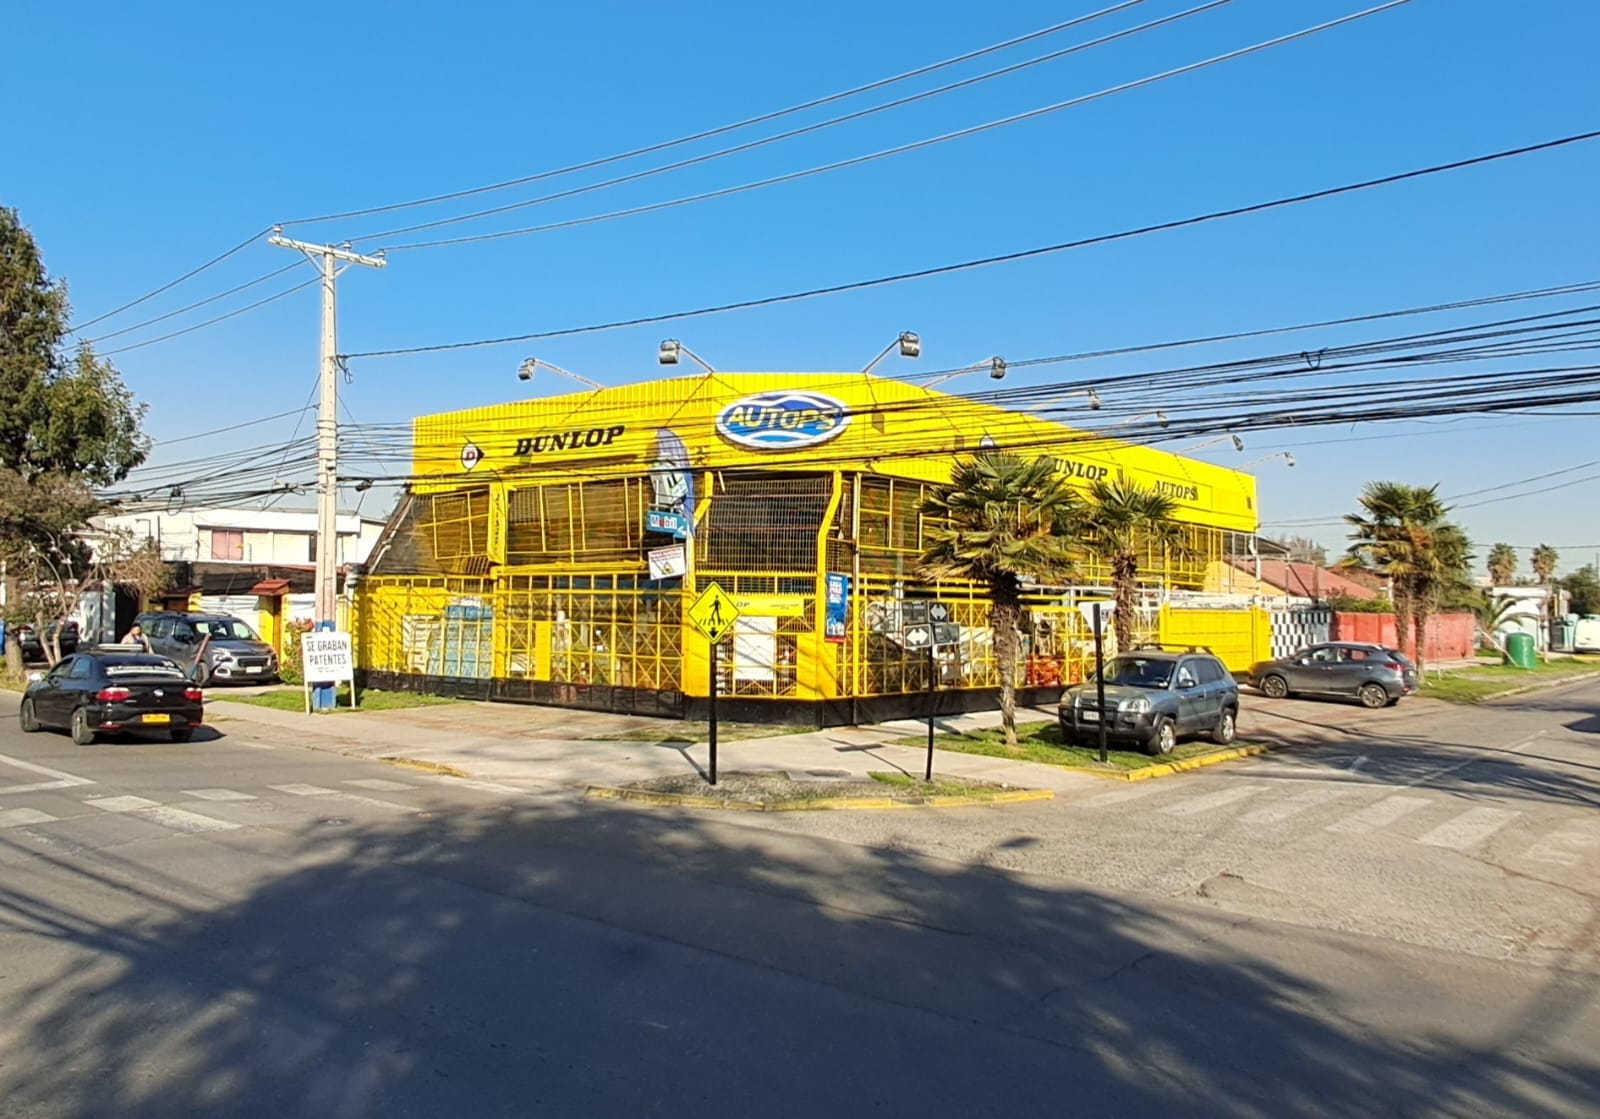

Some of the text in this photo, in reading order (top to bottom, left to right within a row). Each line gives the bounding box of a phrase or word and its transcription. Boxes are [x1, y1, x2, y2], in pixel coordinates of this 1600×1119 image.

[725, 406, 840, 431] AUTOPS
[512, 425, 626, 456] DUNLOP
[1053, 458, 1109, 481] UNLOP
[1153, 480, 1199, 501] AUTOPS
[650, 514, 678, 530] Mobil
[306, 640, 348, 652] SE GRABAN
[309, 653, 347, 667] PATENTES
